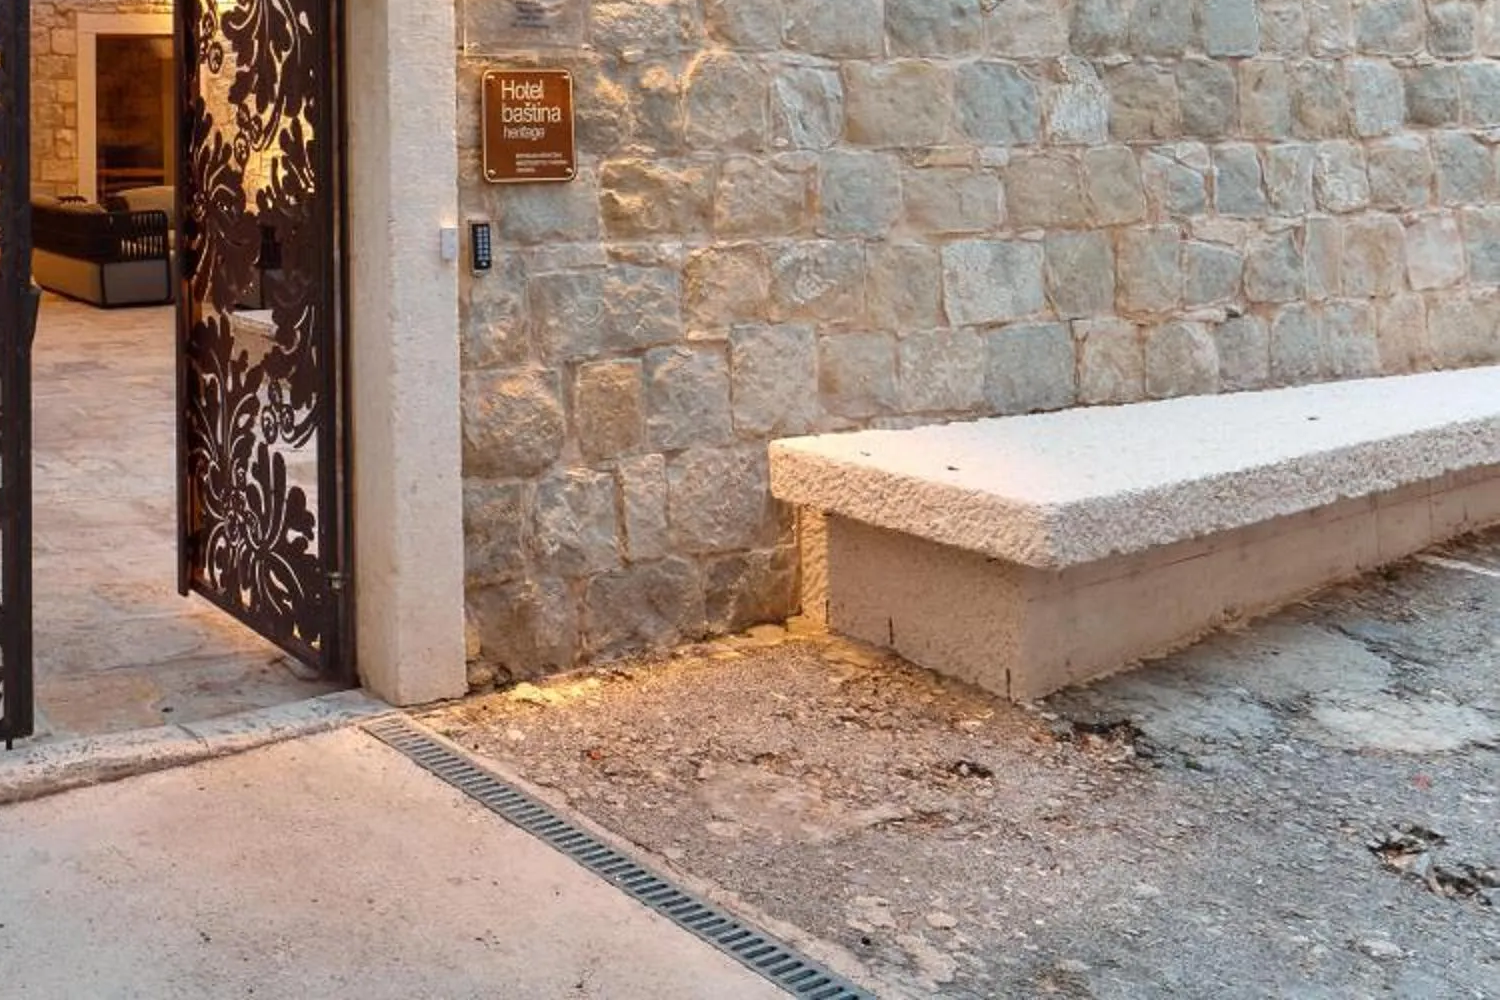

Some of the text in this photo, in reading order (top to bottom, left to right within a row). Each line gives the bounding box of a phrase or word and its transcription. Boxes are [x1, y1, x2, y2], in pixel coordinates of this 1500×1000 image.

[501, 79, 544, 100] Hotel
[501, 102, 561, 123] baština
[503, 125, 545, 141] heritage
